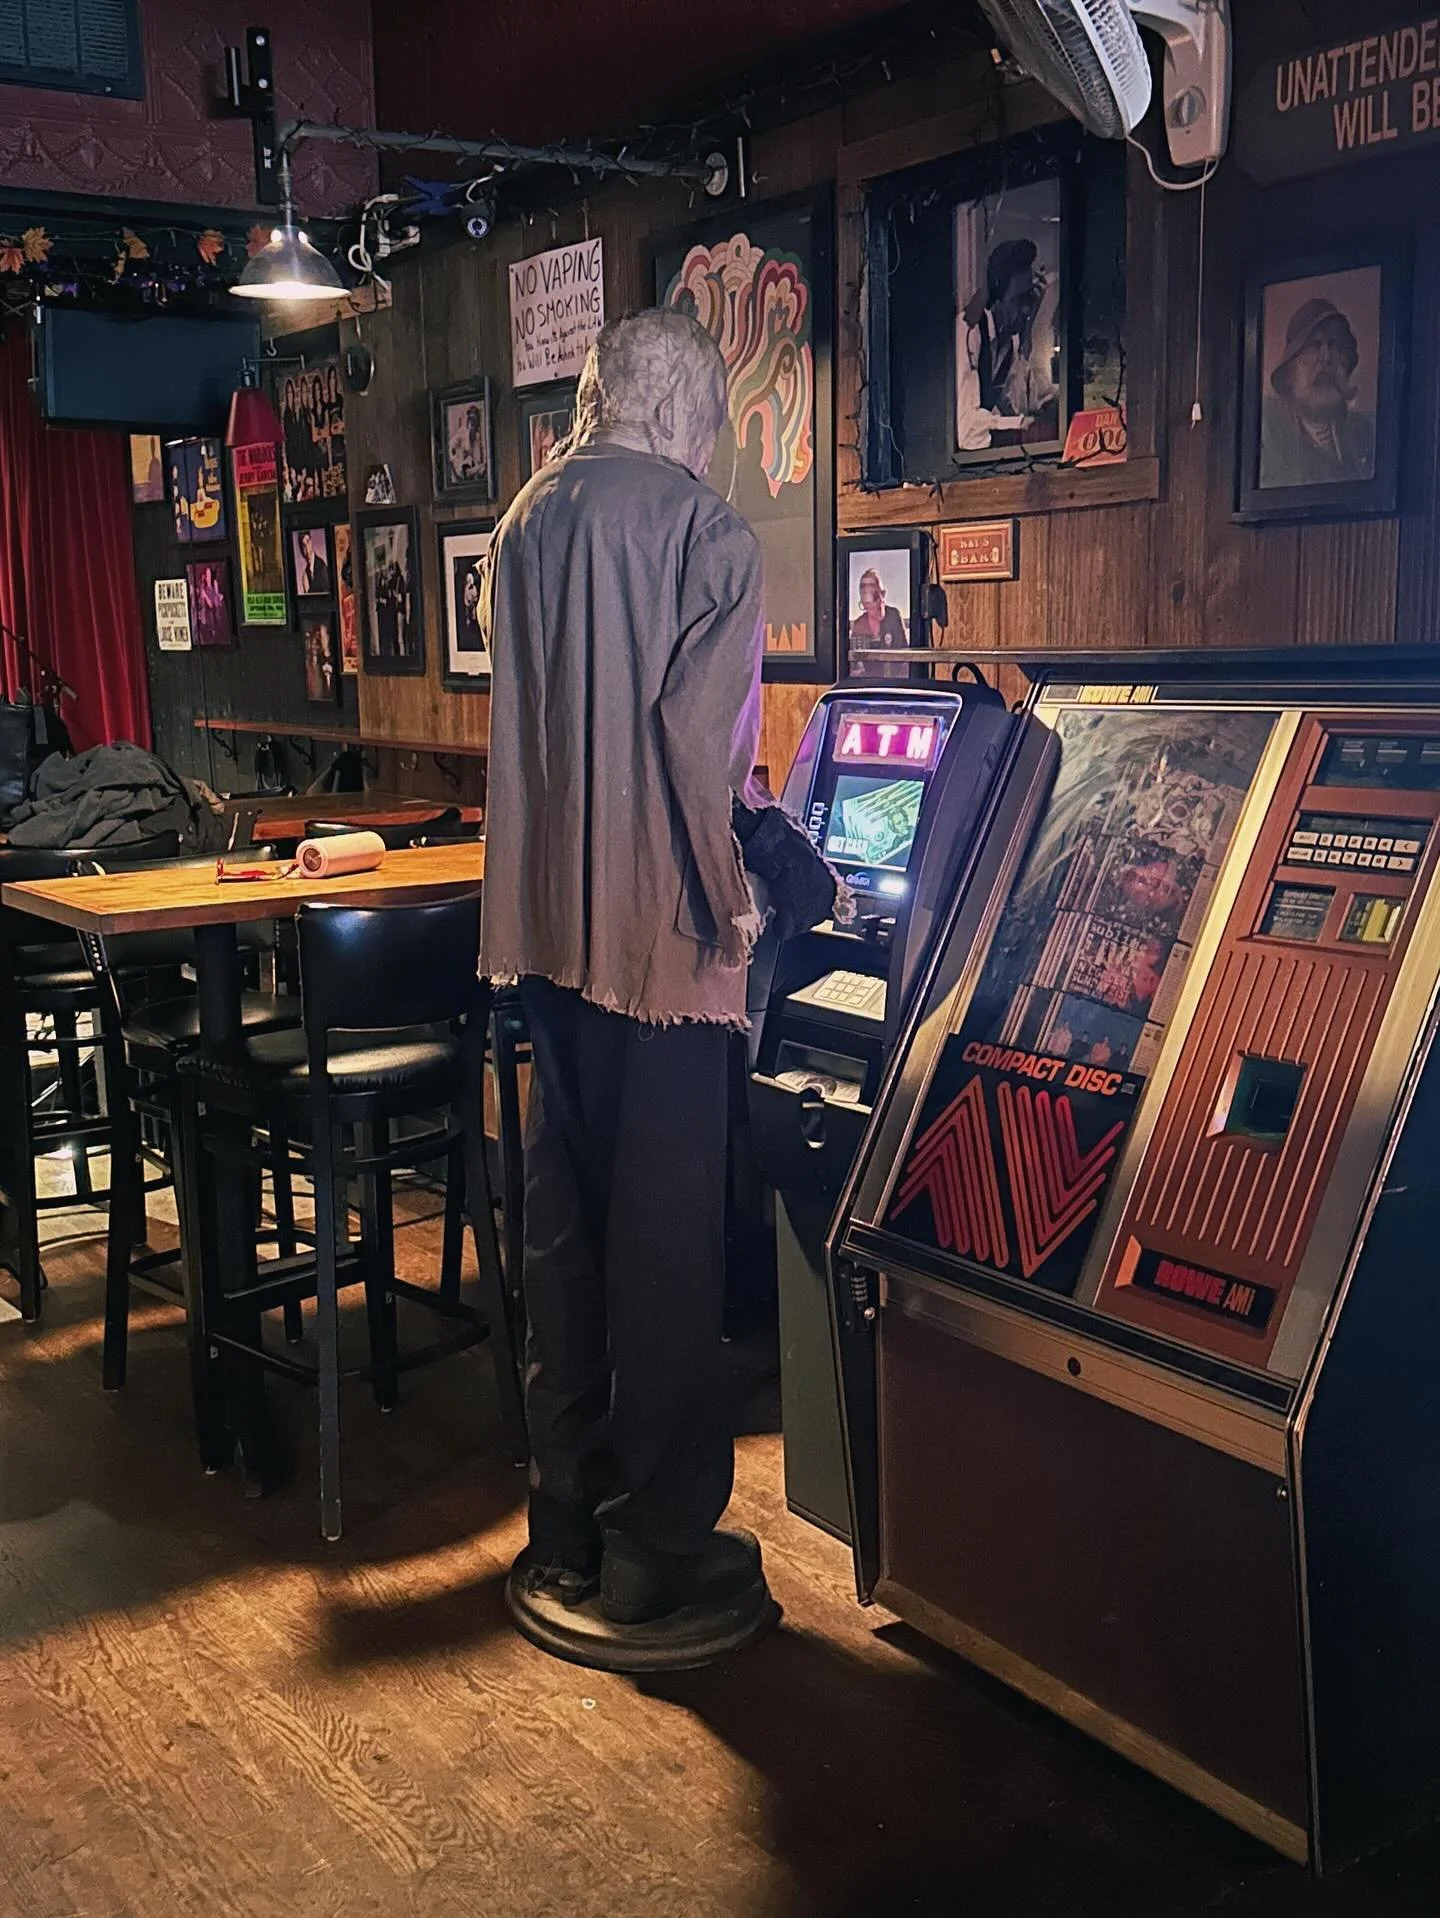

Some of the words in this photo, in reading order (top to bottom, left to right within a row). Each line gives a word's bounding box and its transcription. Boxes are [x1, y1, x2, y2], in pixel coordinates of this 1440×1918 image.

[1276, 19, 1440, 112] UNATTENDE
[1333, 90, 1398, 152] WILL
[515, 265, 537, 302] NO
[540, 242, 600, 294] VAPING
[515, 307, 535, 344] NO
[539, 286, 600, 327] SMOKING
[158, 582, 184, 600] BEWARE
[841, 723, 933, 760] ATM
[1090, 922, 1149, 951] sublime
[962, 1041, 1065, 1082] COMPACT
[1063, 1063, 1123, 1096] DISC
[1153, 1259, 1227, 1304] ROWE
